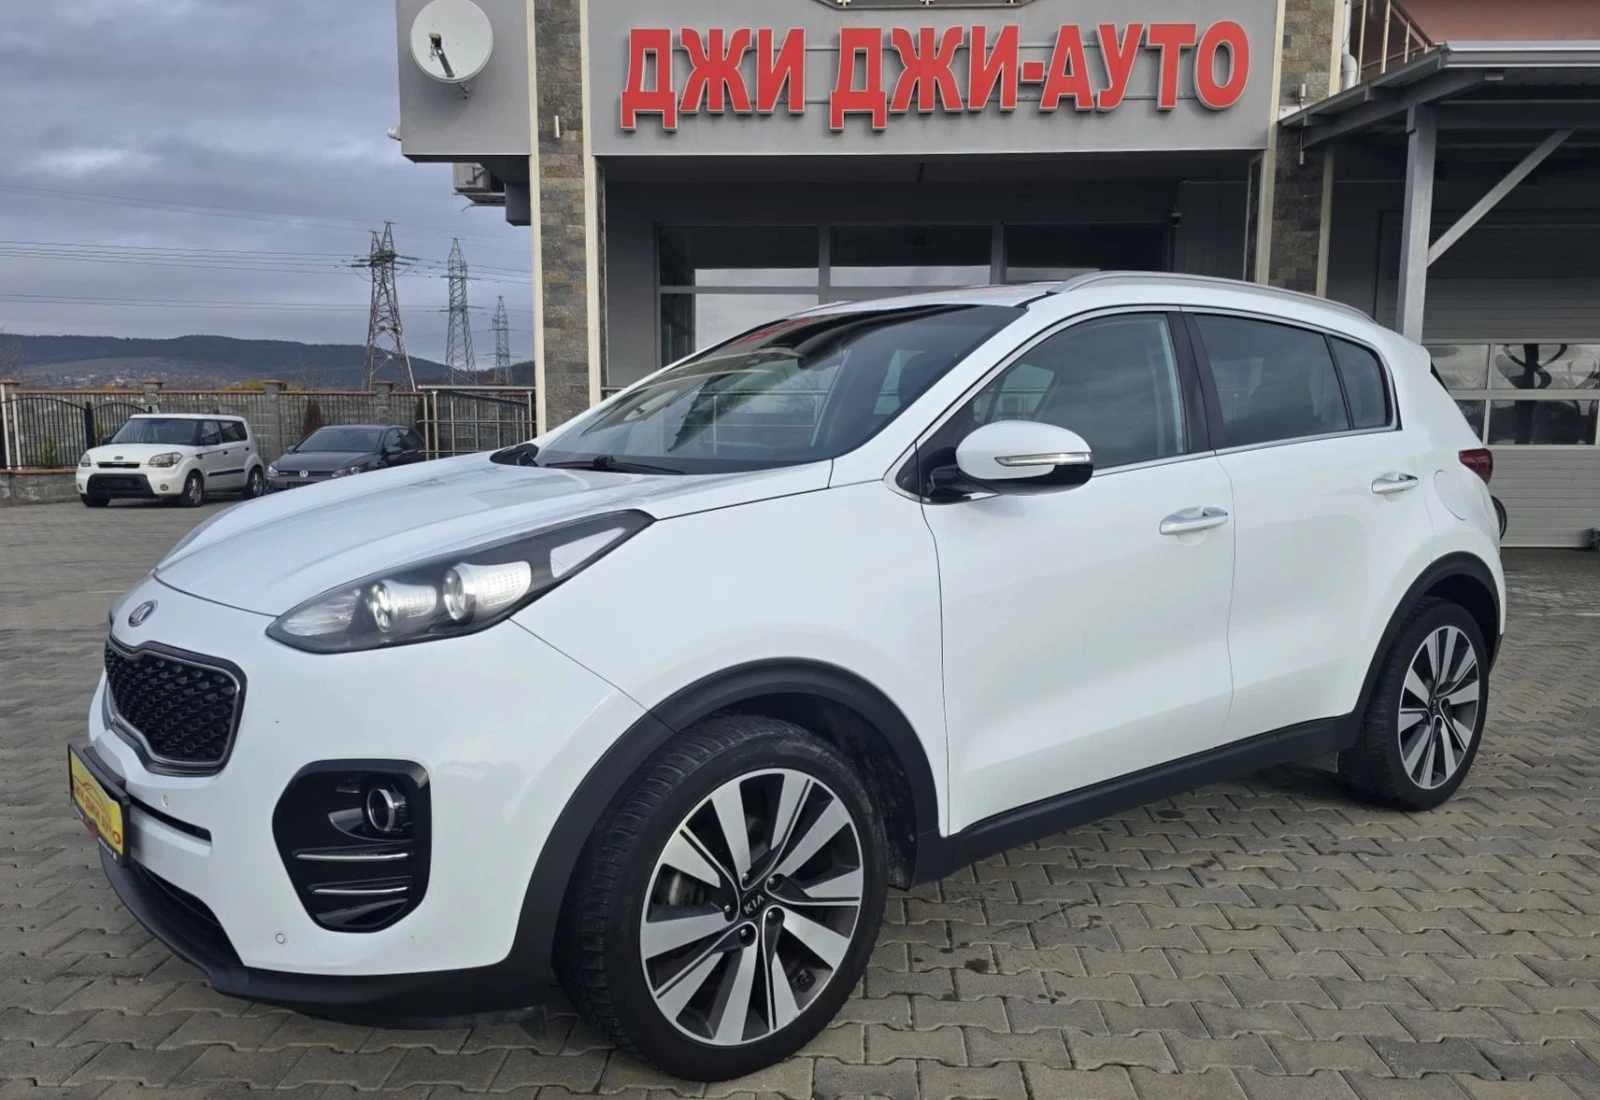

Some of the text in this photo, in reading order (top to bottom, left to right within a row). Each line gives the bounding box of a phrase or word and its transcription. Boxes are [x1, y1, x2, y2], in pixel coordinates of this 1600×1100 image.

[621, 20, 1250, 131] ДЖИ ДЖИ-АУТО
[744, 895, 764, 914] KIA
